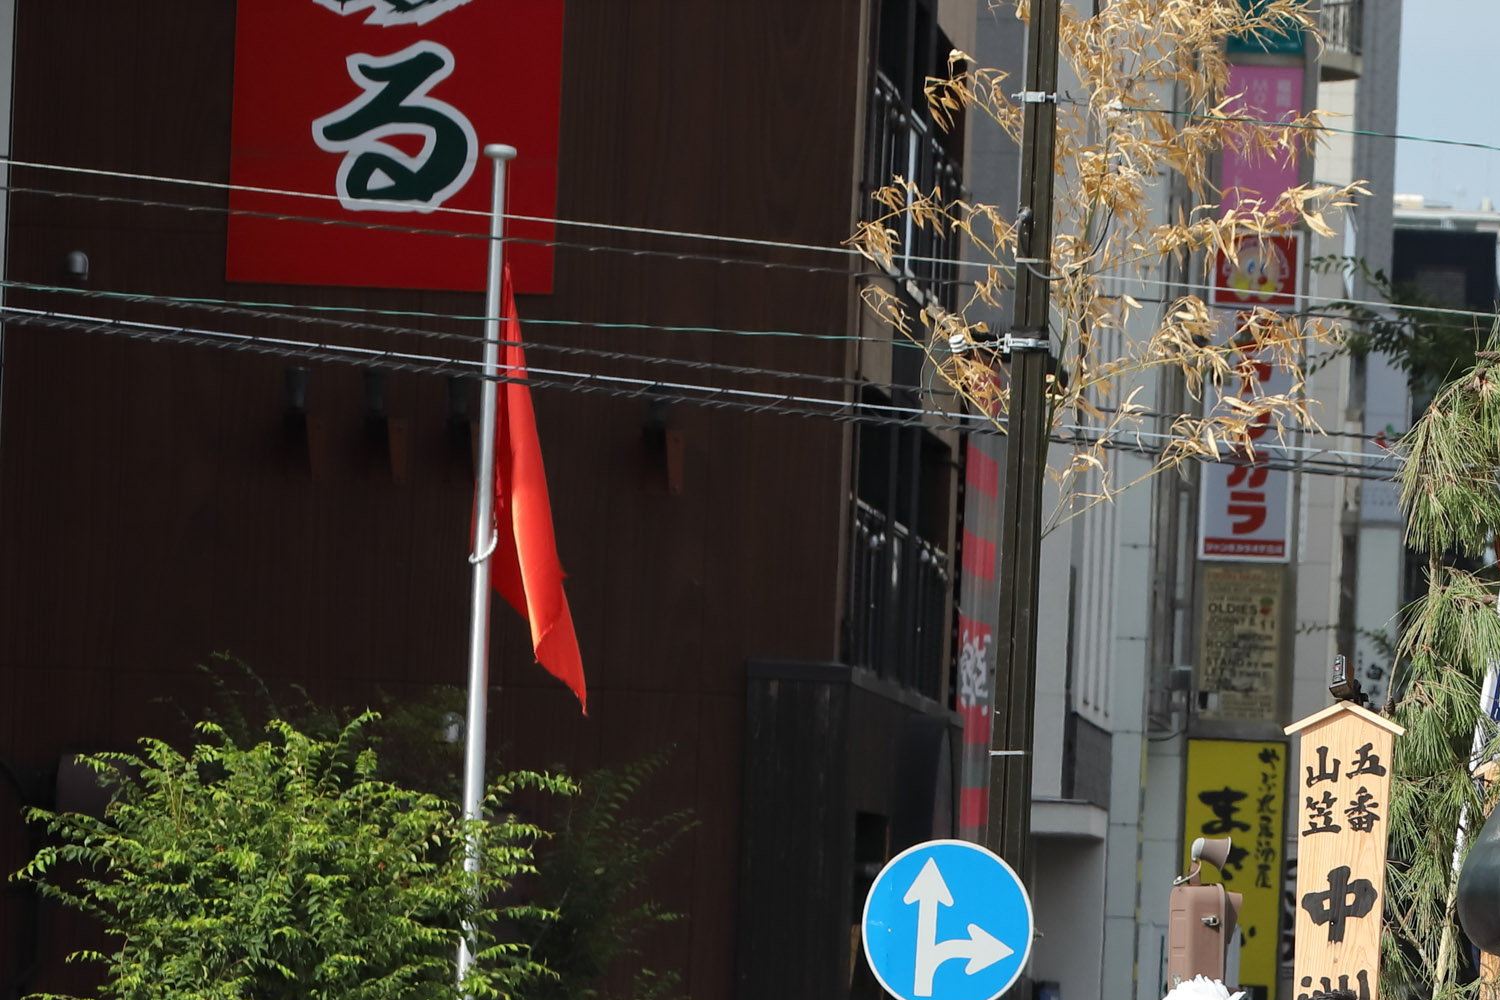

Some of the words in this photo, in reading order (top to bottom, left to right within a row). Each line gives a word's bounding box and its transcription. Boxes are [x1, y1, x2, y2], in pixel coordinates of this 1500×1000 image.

[1207, 602, 1258, 616] OLDIES
[1302, 745, 1342, 837] 山笠
[1344, 742, 1387, 834] 五番
